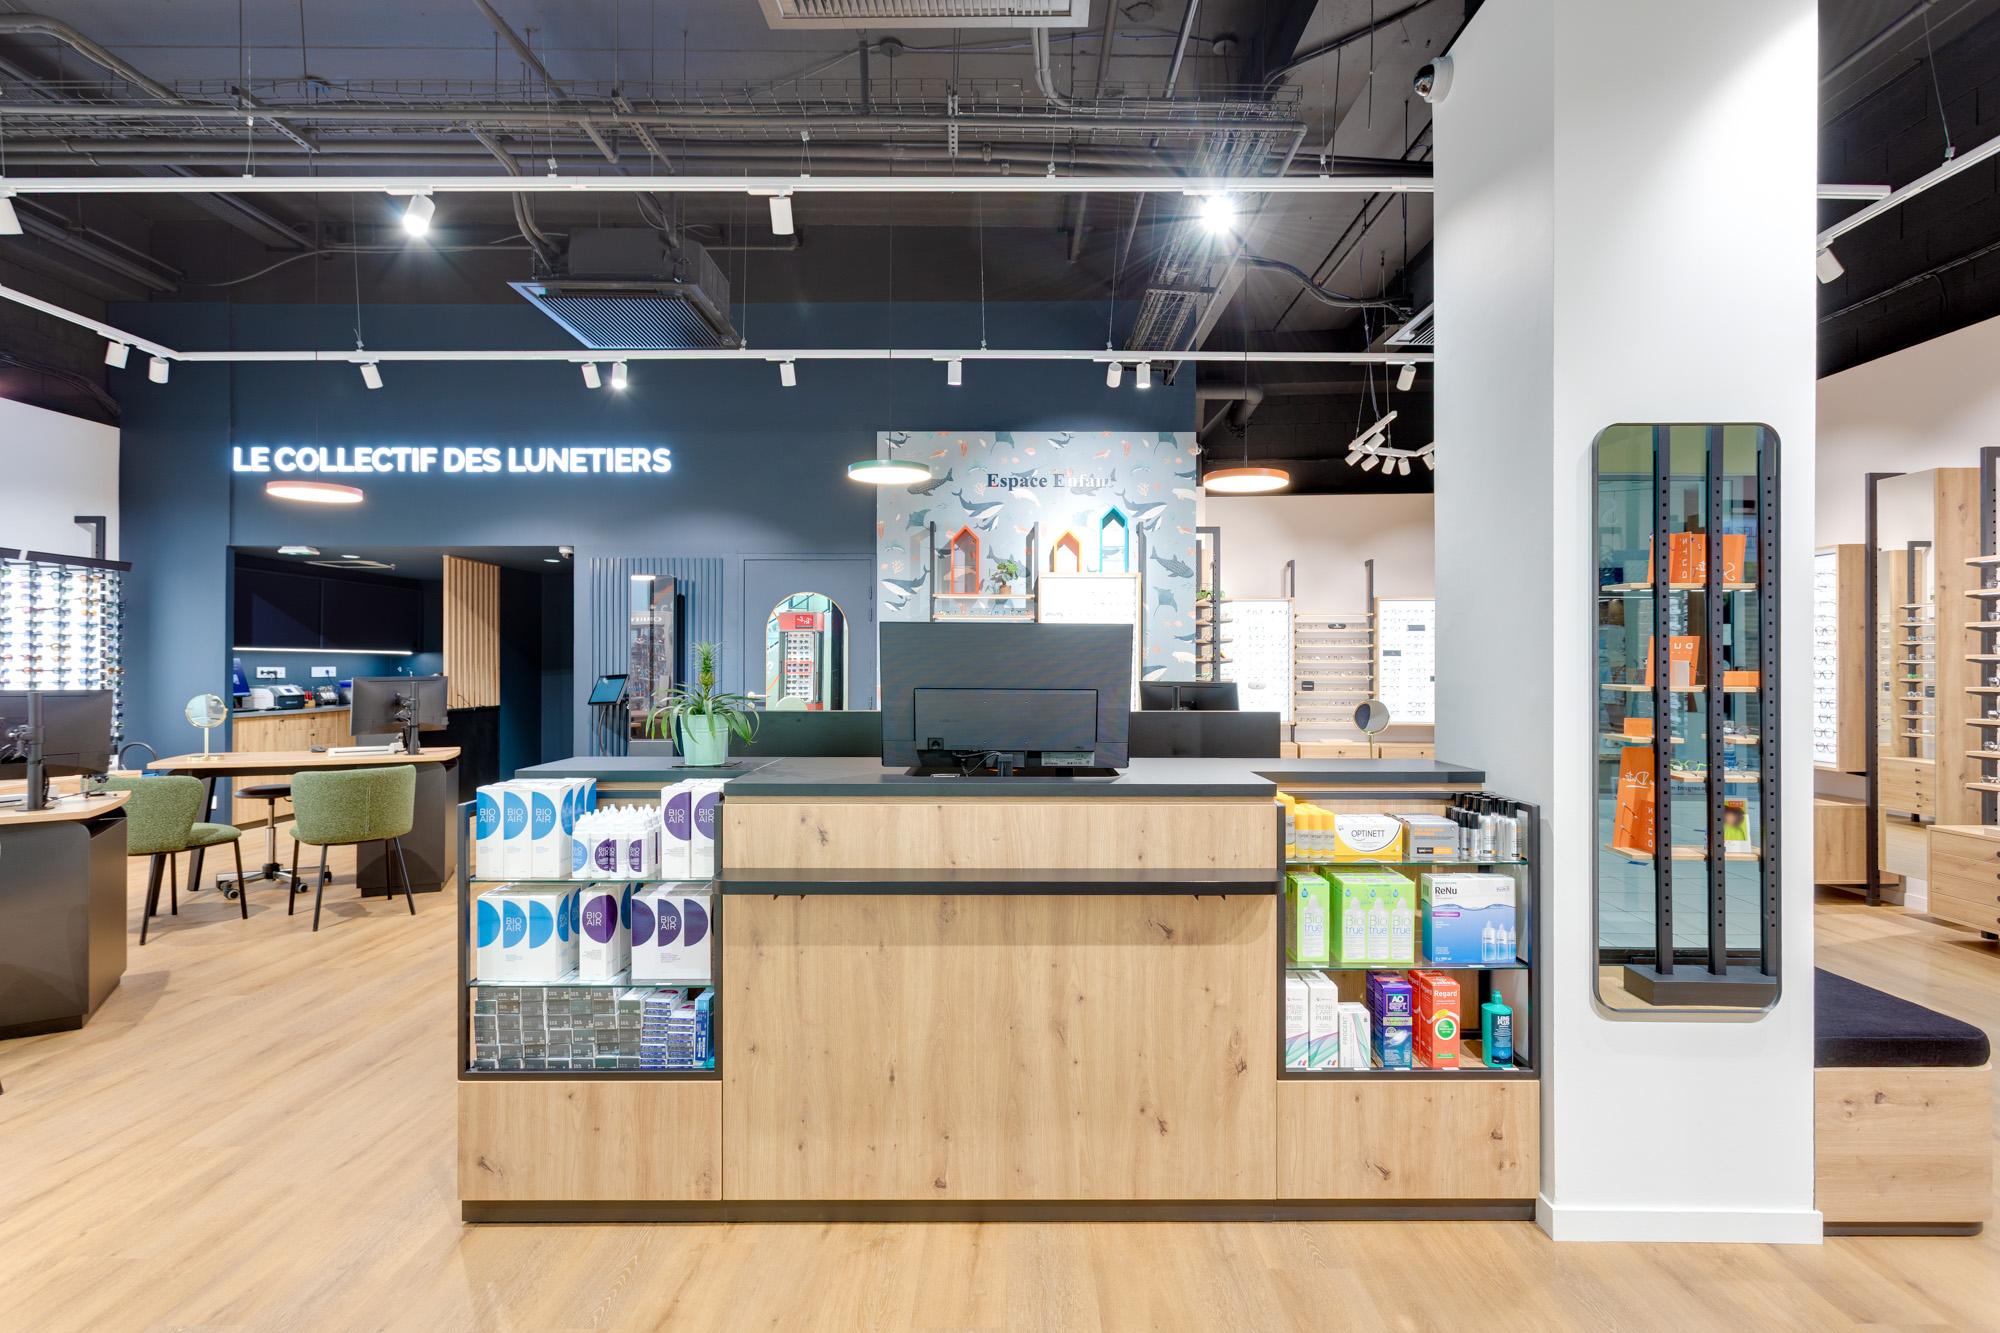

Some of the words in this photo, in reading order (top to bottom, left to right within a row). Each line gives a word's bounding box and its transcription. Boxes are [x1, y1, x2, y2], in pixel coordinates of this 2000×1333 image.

[233, 446, 269, 472] LE
[273, 446, 440, 473] COLLECTIF
[443, 446, 502, 473] DES
[507, 446, 672, 473] LUNETIERS
[987, 473, 1047, 491] Espace
[480, 808, 496, 816] BIO
[507, 808, 523, 816] BIO
[536, 808, 552, 816] BIO
[668, 808, 684, 816] BIO
[699, 808, 714, 816] BIO
[668, 816, 684, 824] AIR
[1351, 829, 1385, 838] OPTINETT
[1434, 886, 1457, 895] ReNu
[586, 918, 602, 926] AIR
[1304, 912, 1322, 924] Bio
[1346, 915, 1364, 926] Bio
[1370, 915, 1387, 926] Bio
[1392, 915, 1411, 926] Bio
[506, 924, 522, 932] AIR
[1304, 924, 1322, 932] true
[1346, 926, 1364, 934] true
[1370, 926, 1387, 934] true
[1392, 926, 1411, 934] true
[1434, 990, 1457, 998] Regard
[1391, 995, 1404, 1003] AO
